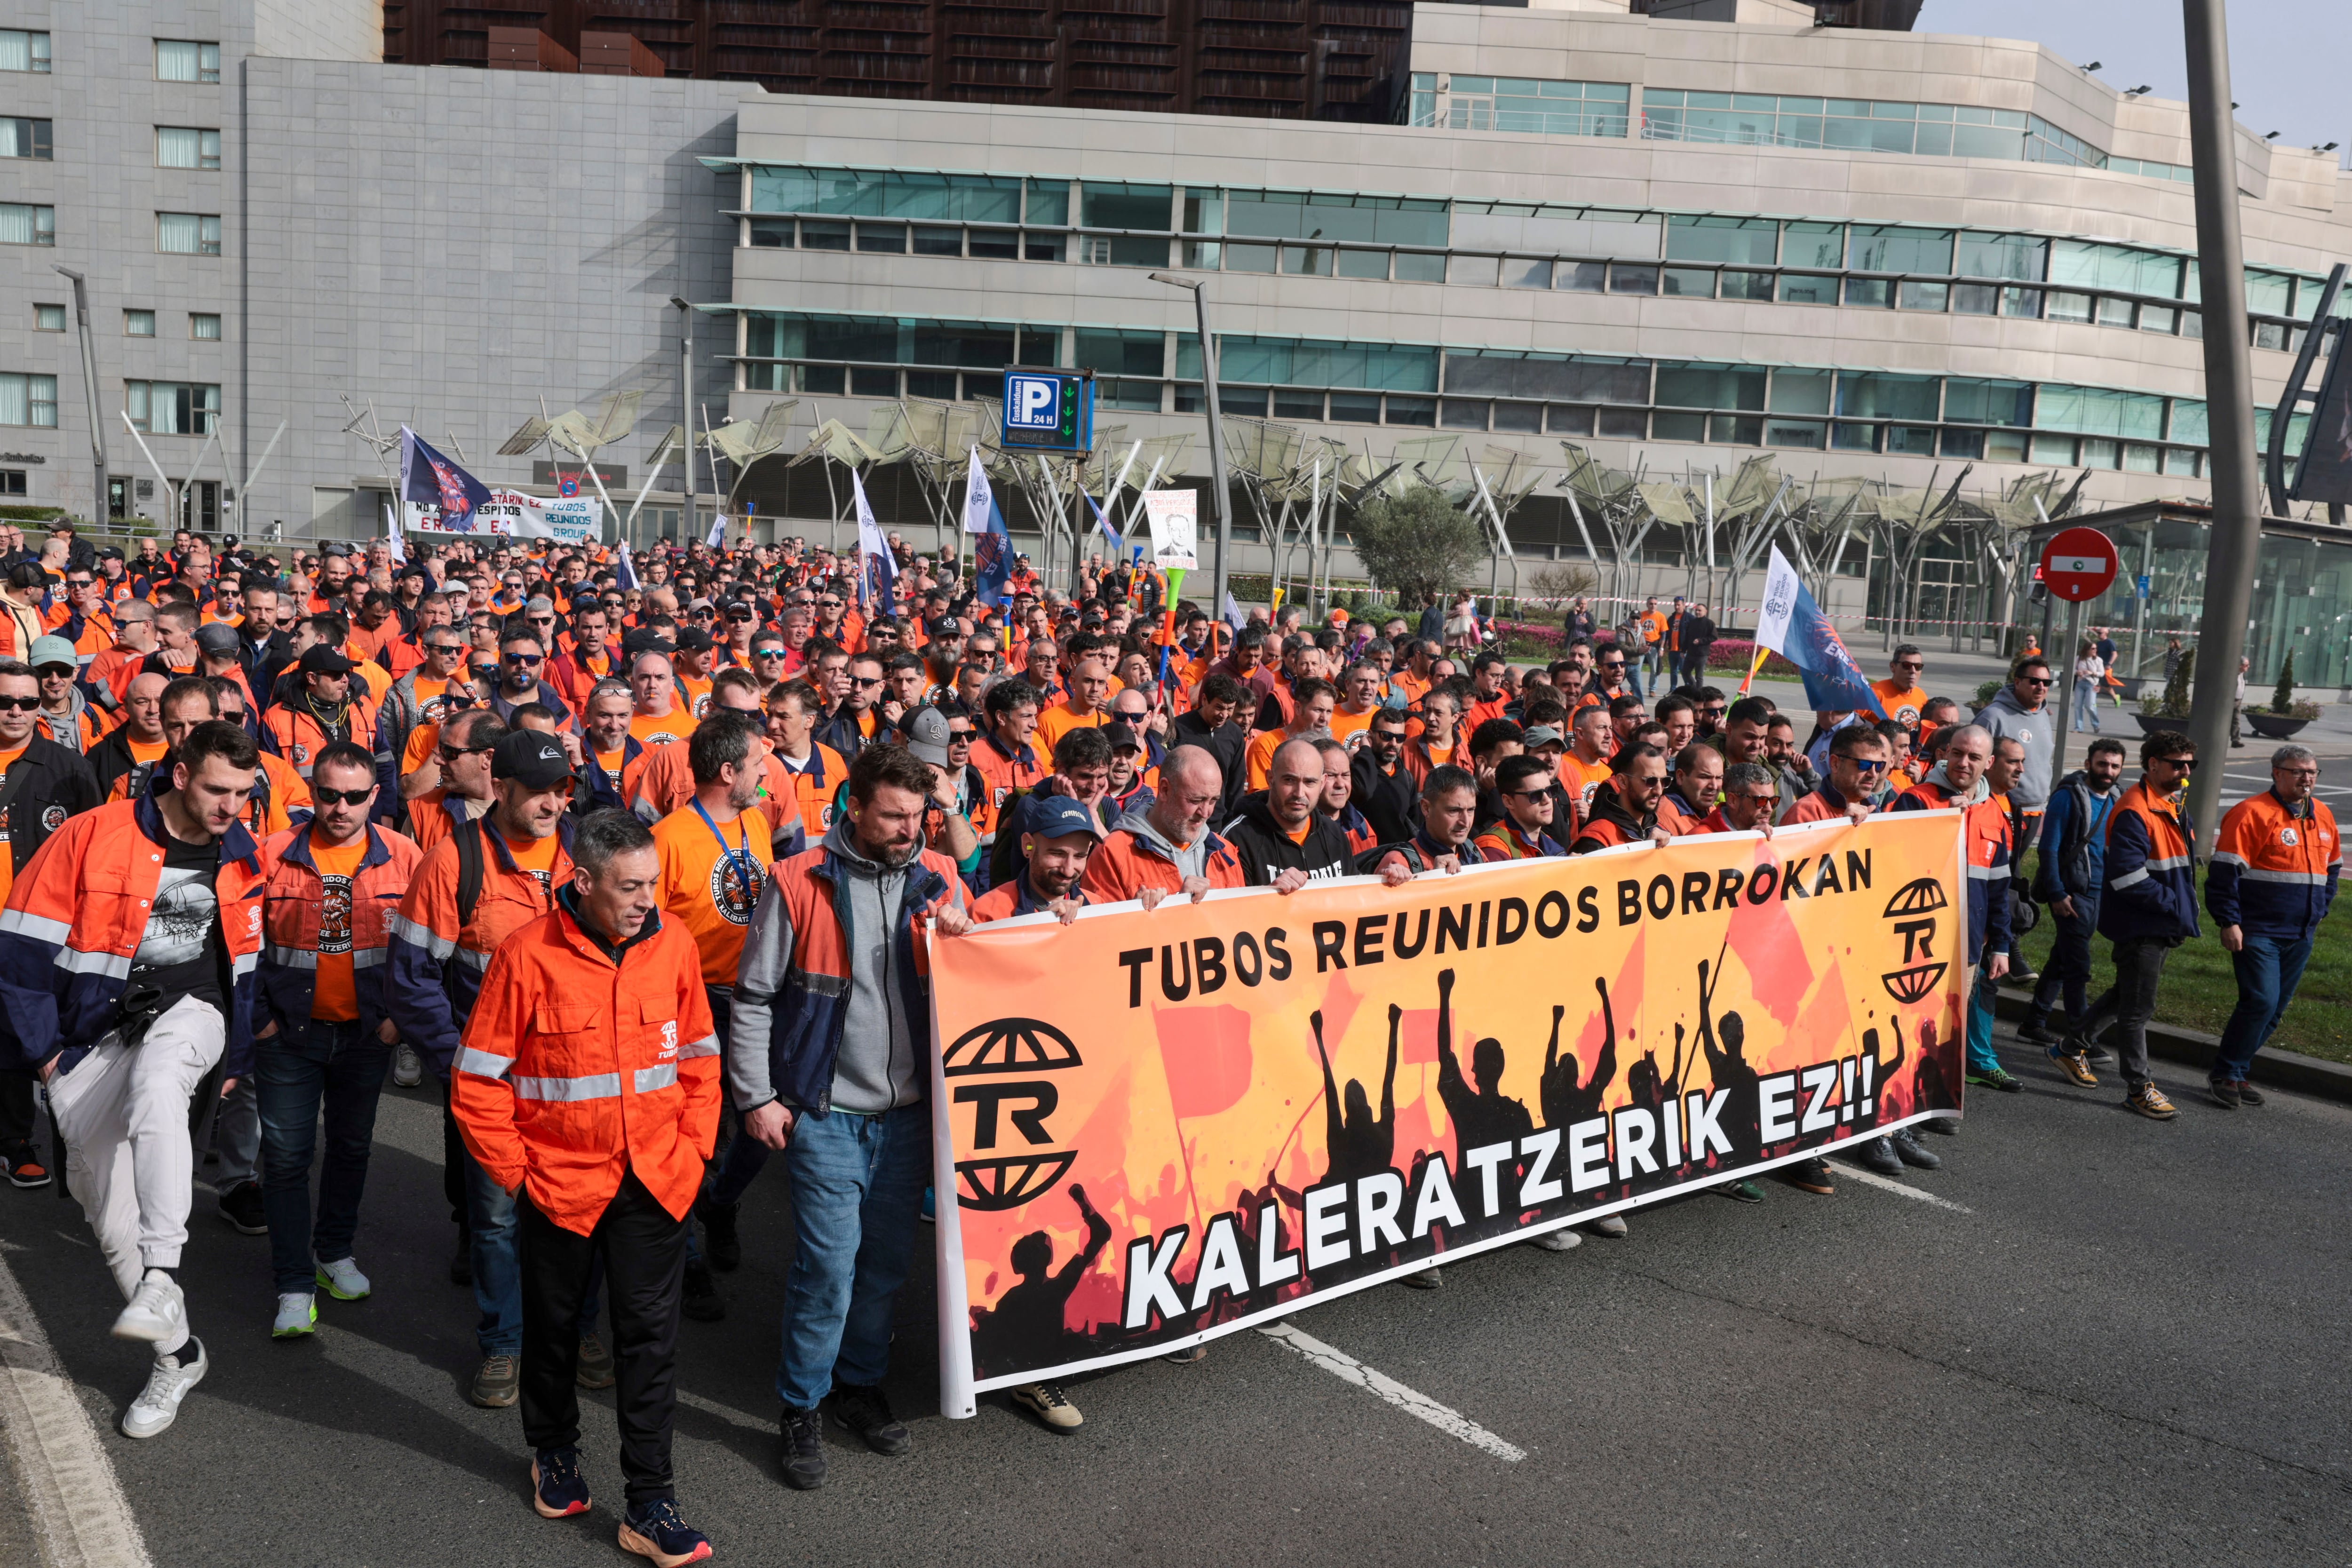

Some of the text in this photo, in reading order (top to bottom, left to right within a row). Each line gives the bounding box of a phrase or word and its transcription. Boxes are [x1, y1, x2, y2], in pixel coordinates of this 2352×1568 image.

[1013, 381, 1021, 422] Euskalduna
[1021, 381, 1051, 423] P
[1033, 415, 1053, 424] 24 H
[452, 473, 465, 489] ERE
[416, 502, 429, 512] NO
[486, 495, 541, 508] ETARIK EZ
[552, 503, 587, 512] TUBOS
[545, 513, 591, 525] REUNIDOS
[553, 527, 587, 539] GROUP
[1778, 573, 1788, 598] REUNIDOS
[1825, 641, 1850, 666] ERE
[421, 696, 441, 707] REUNID
[1347, 731, 1367, 741] REUNIDOS
[323, 876, 347, 884] NIDOS
[712, 873, 721, 901] TUBOS
[749, 854, 766, 887] RROKAN
[718, 904, 749, 923] KALERATZ
[1120, 848, 1872, 1008] TUBOS REUNIDOS BORROKAN
[1894, 918, 1937, 963] TR
[953, 1081, 1058, 1149] TR
[1126, 1055, 1875, 1329] KALERATZERIK EZ!!
